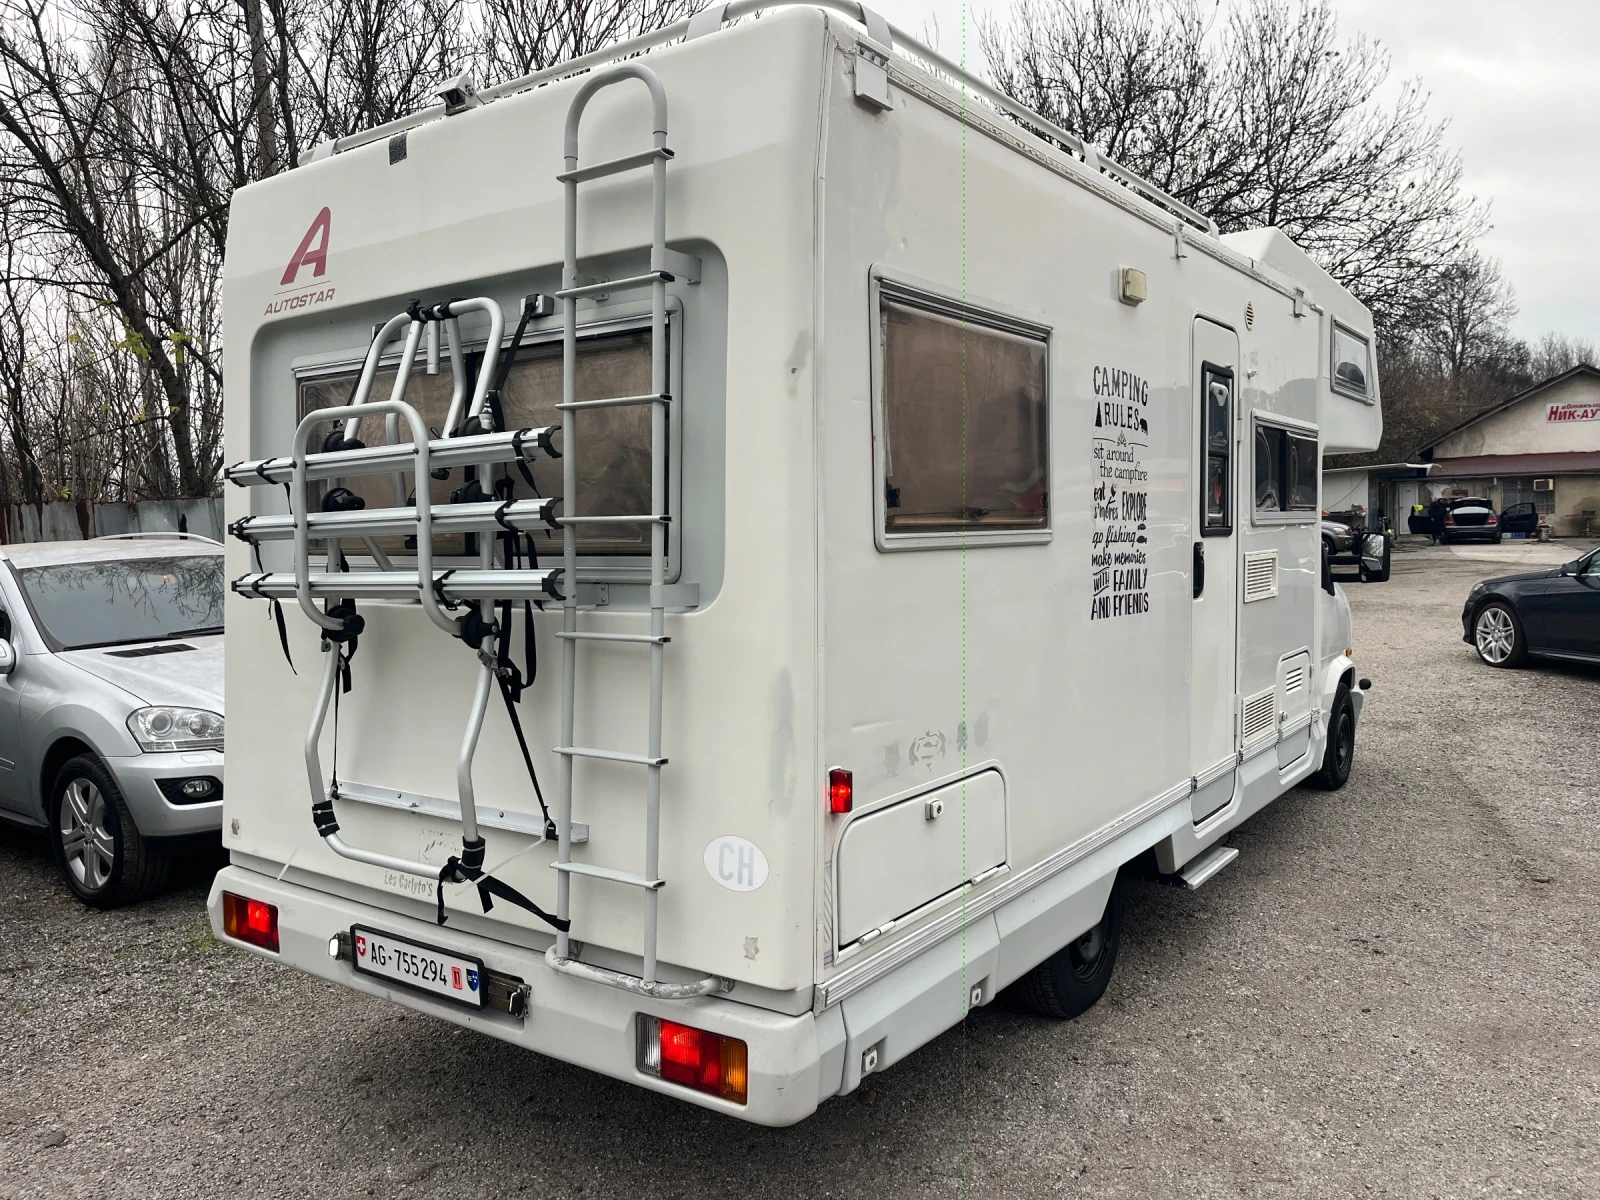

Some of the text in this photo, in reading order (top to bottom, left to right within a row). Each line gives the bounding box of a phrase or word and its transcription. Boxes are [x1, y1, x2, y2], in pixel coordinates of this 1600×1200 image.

[280, 206, 332, 286] A
[264, 288, 336, 316] AUTOSTAR
[1093, 365, 1149, 407] CAMPING
[1104, 402, 1140, 431] RULES
[1093, 442, 1134, 463] sit around
[1100, 460, 1148, 484] the campfire
[1093, 481, 1106, 501] eat
[1122, 491, 1148, 521] EXPLORE
[1092, 525, 1137, 549] go fishing
[1091, 547, 1146, 567] make memories
[1113, 568, 1148, 592] FAMILY
[1090, 596, 1111, 621] AND
[718, 842, 755, 887] CH
[384, 871, 397, 887] Les
